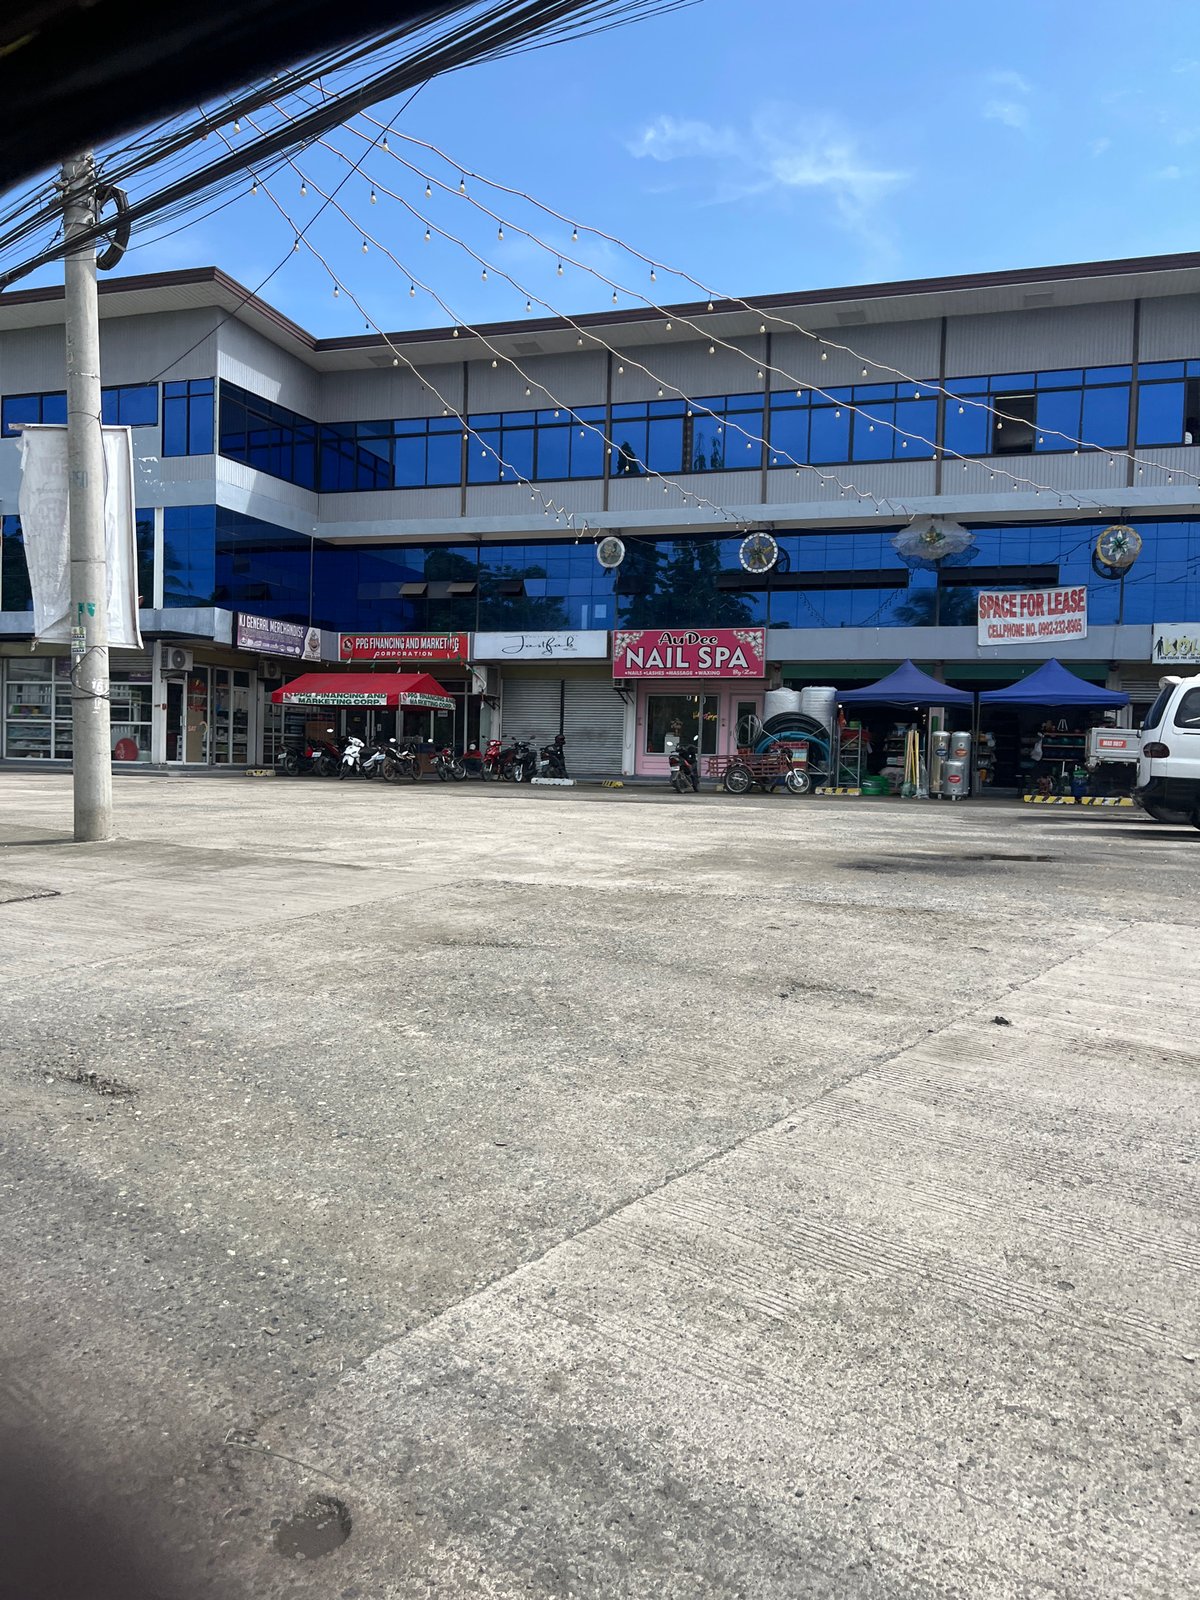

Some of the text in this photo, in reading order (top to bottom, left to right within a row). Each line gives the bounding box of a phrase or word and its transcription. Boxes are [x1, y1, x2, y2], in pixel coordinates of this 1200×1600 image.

[980, 588, 1085, 619] SPACE FOR LEASE
[239, 614, 246, 627] KJ
[246, 615, 269, 632] GENERAL
[269, 620, 304, 638] MERCHANDISE
[988, 623, 1025, 639] CELLPHONE
[1026, 624, 1037, 637] NO.
[355, 638, 369, 649] PPG
[369, 637, 405, 650] FINANCING
[405, 638, 419, 649] AND
[658, 631, 719, 646] AuDee
[625, 646, 749, 669] NAIL SPA
